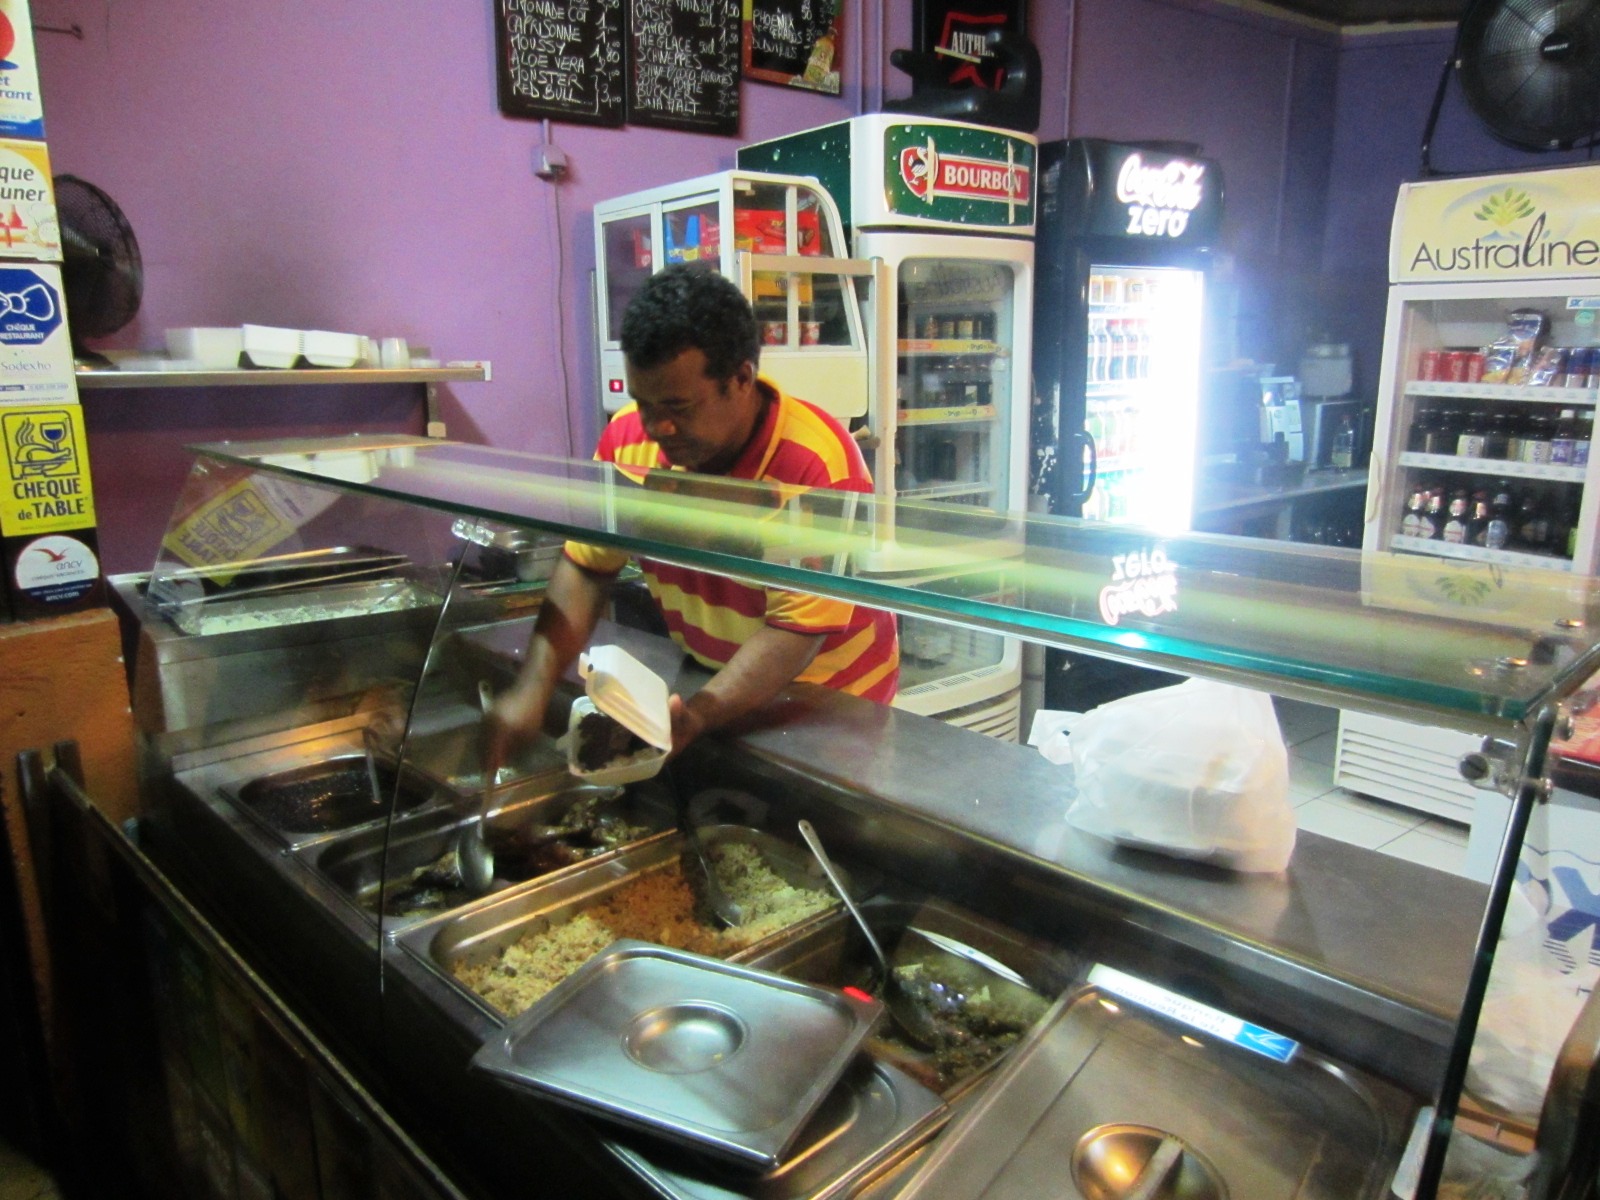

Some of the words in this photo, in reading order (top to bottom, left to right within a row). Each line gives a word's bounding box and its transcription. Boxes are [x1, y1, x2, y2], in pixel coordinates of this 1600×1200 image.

[635, 2, 673, 21] OASIS
[507, 14, 582, 42] CAPRISONNE
[510, 34, 566, 56] MOUSSY
[510, 48, 549, 67] ALOE
[554, 55, 585, 74] VERA
[510, 66, 584, 92] MONSTER
[512, 82, 540, 98] RED
[542, 84, 582, 103] BULL
[1127, 205, 1190, 238] zero
[1410, 211, 1599, 272] Australine
[1, 361, 52, 371] Sodexho
[13, 478, 83, 500] CHEQUE
[18, 508, 33, 521] de
[31, 498, 86, 520] TABLE
